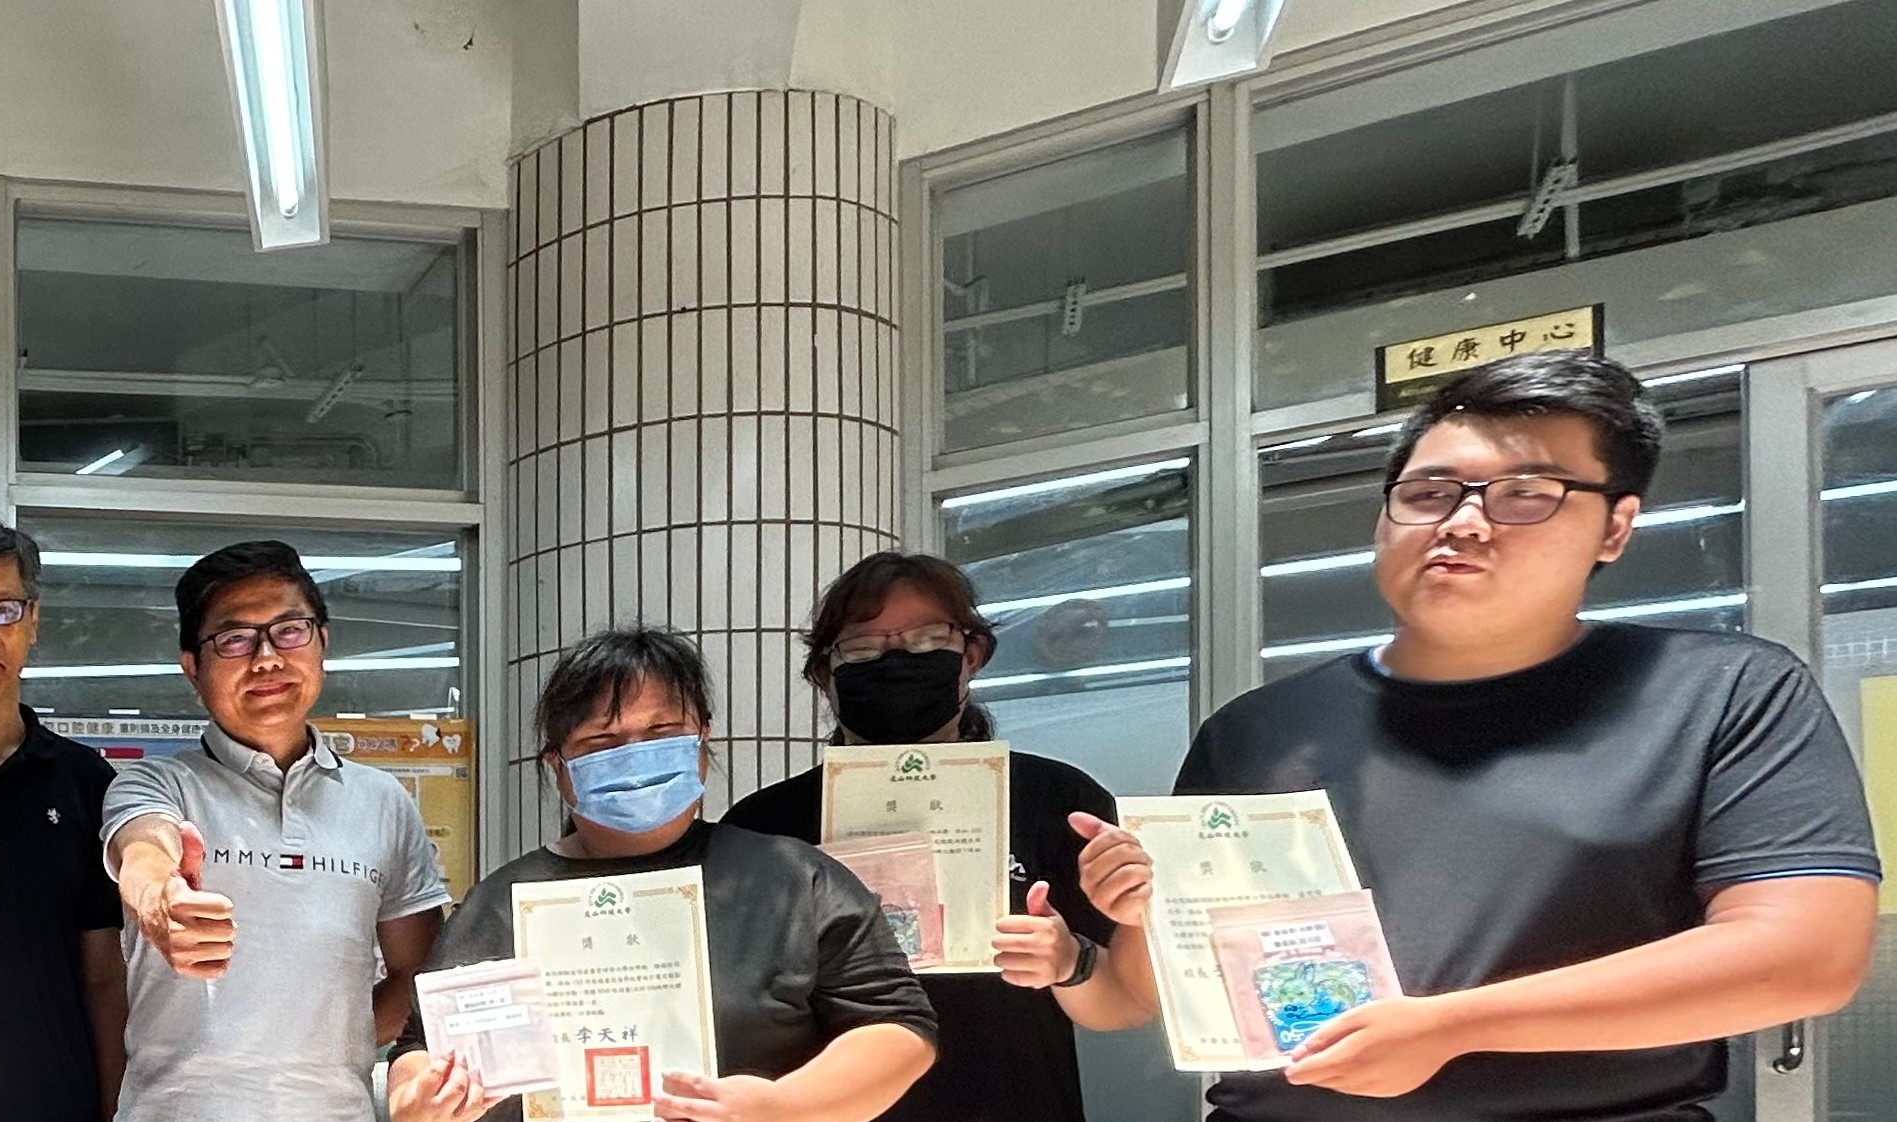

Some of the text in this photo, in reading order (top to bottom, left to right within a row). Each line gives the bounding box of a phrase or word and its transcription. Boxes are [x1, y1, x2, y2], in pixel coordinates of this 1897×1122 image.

[1407, 323, 1576, 370] 健康中心
[204, 849, 272, 868] MMY
[575, 1024, 639, 1045] 李天祥
